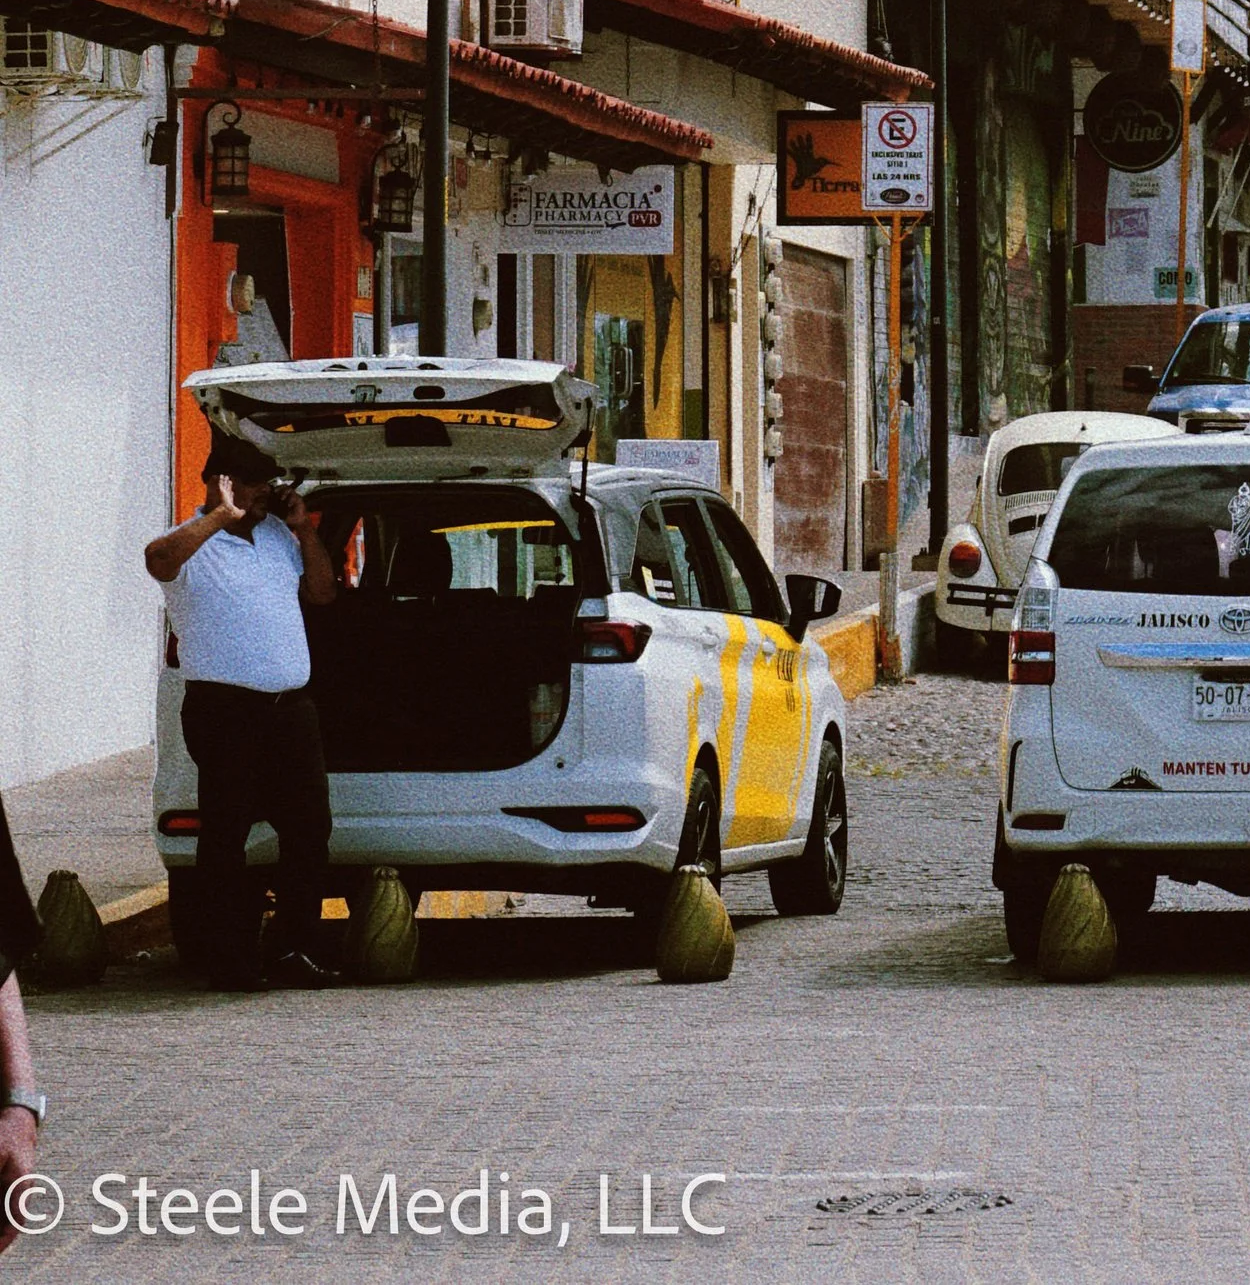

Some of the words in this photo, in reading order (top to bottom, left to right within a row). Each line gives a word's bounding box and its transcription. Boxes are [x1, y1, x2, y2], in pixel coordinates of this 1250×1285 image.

[534, 192, 652, 210] FARMACIA
[534, 210, 625, 222] PHARMACY
[631, 213, 660, 224] PVR
[1136, 613, 1211, 629] JALISCO
[1163, 761, 1226, 776] MANTEN
[1231, 761, 1250, 775] TU
